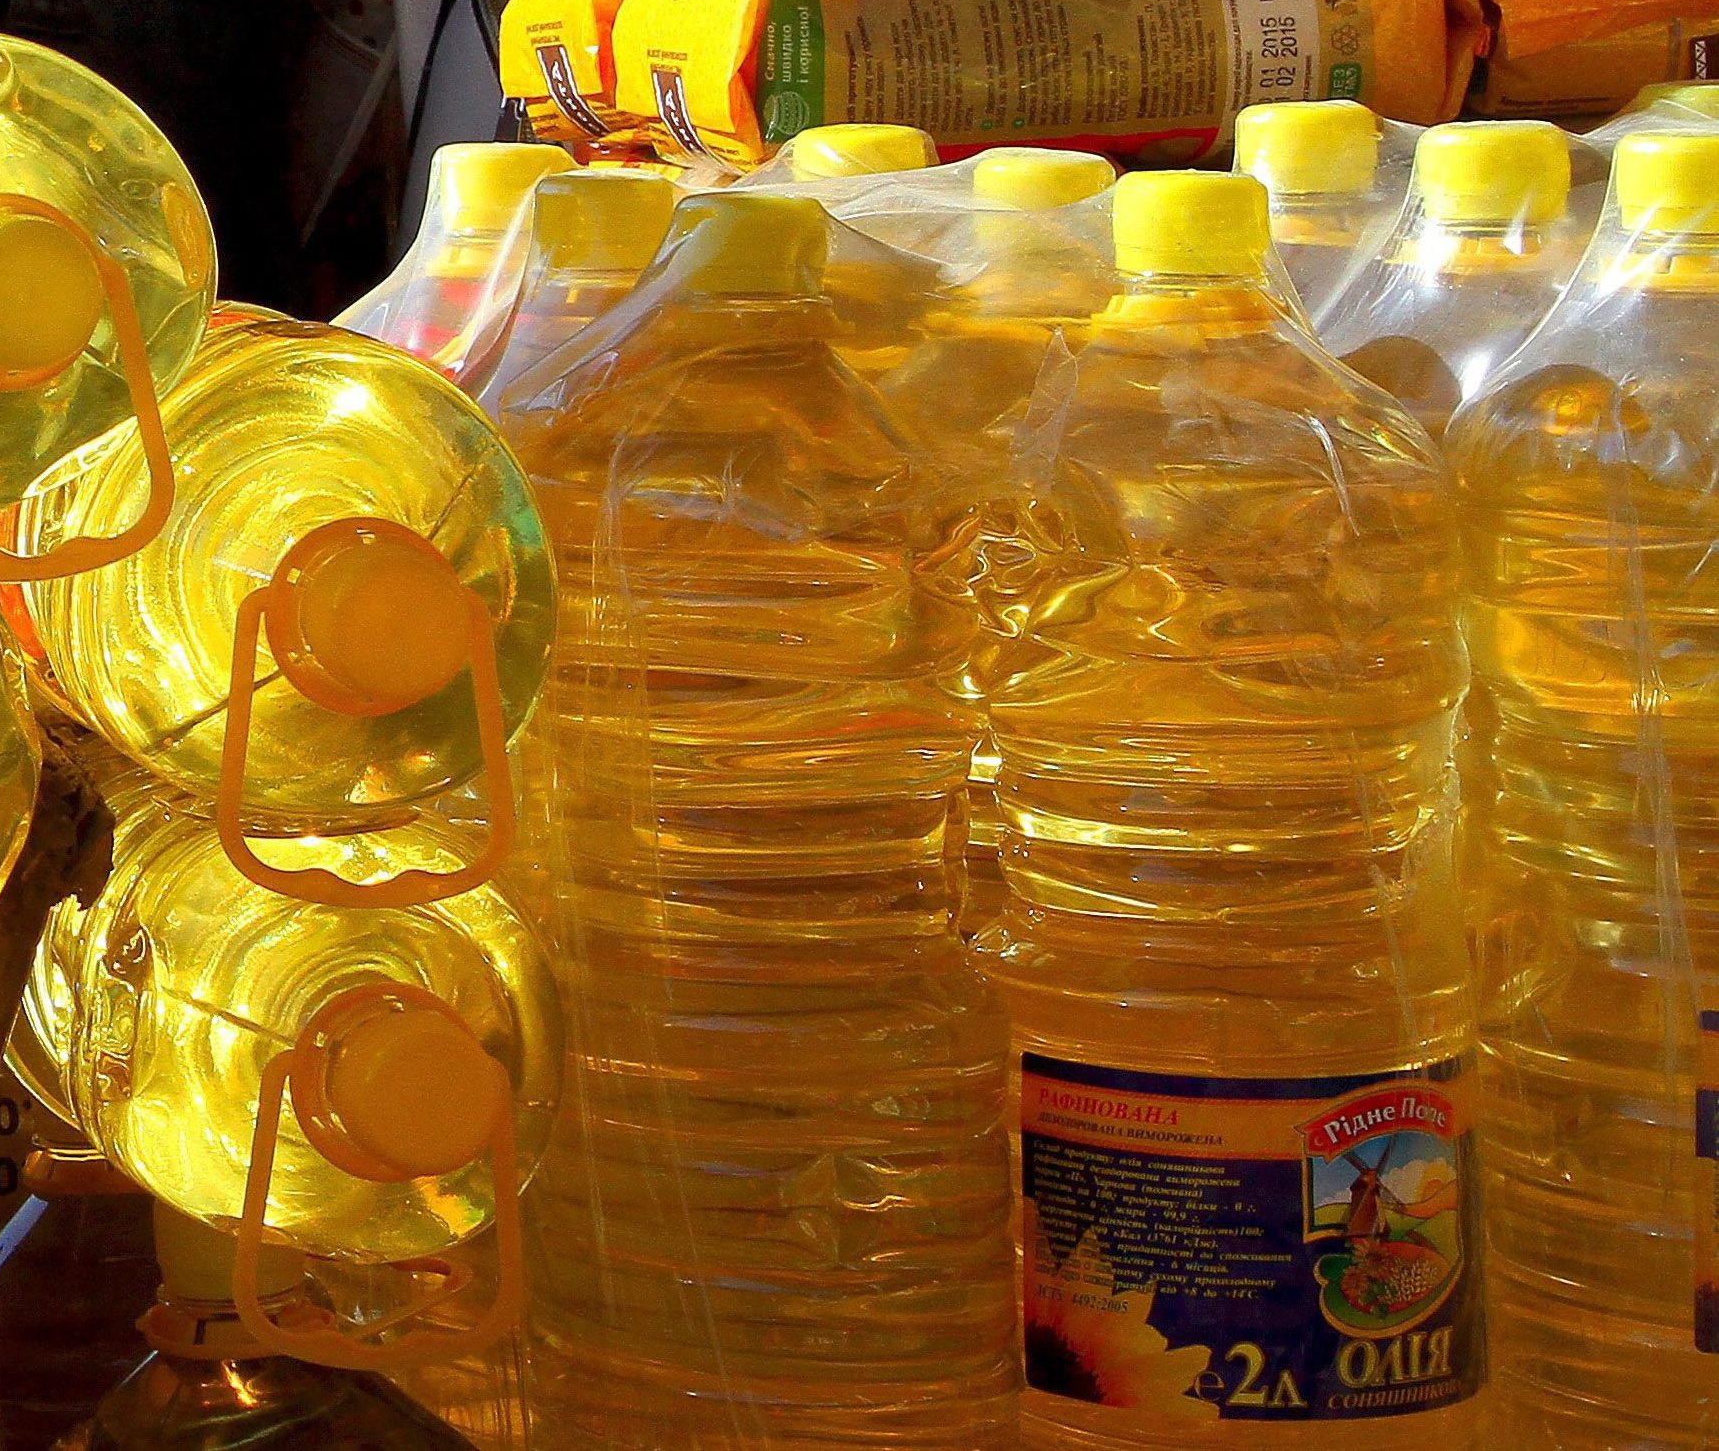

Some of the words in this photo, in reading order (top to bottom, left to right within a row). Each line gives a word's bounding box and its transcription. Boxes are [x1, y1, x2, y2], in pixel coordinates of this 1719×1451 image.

[764, 21, 777, 81] Смачно,
[781, 24, 793, 83] швидко
[797, 6, 813, 75] корисно!
[1260, 16, 1279, 58] 2015
[1277, 16, 1298, 58] 2015
[1259, 68, 1276, 88] 01
[1275, 66, 1296, 87] 02
[1039, 1086, 1180, 1126] РАФІНОВАНА
[1323, 1105, 1396, 1145] Рідне
[1400, 1097, 1447, 1128] Поле
[1126, 1128, 1224, 1146] ВИМОРОЖЕНА
[1336, 1324, 1454, 1389] ОЛІЯ
[1326, 1379, 1461, 1410] СОНЯШНИКОВ
